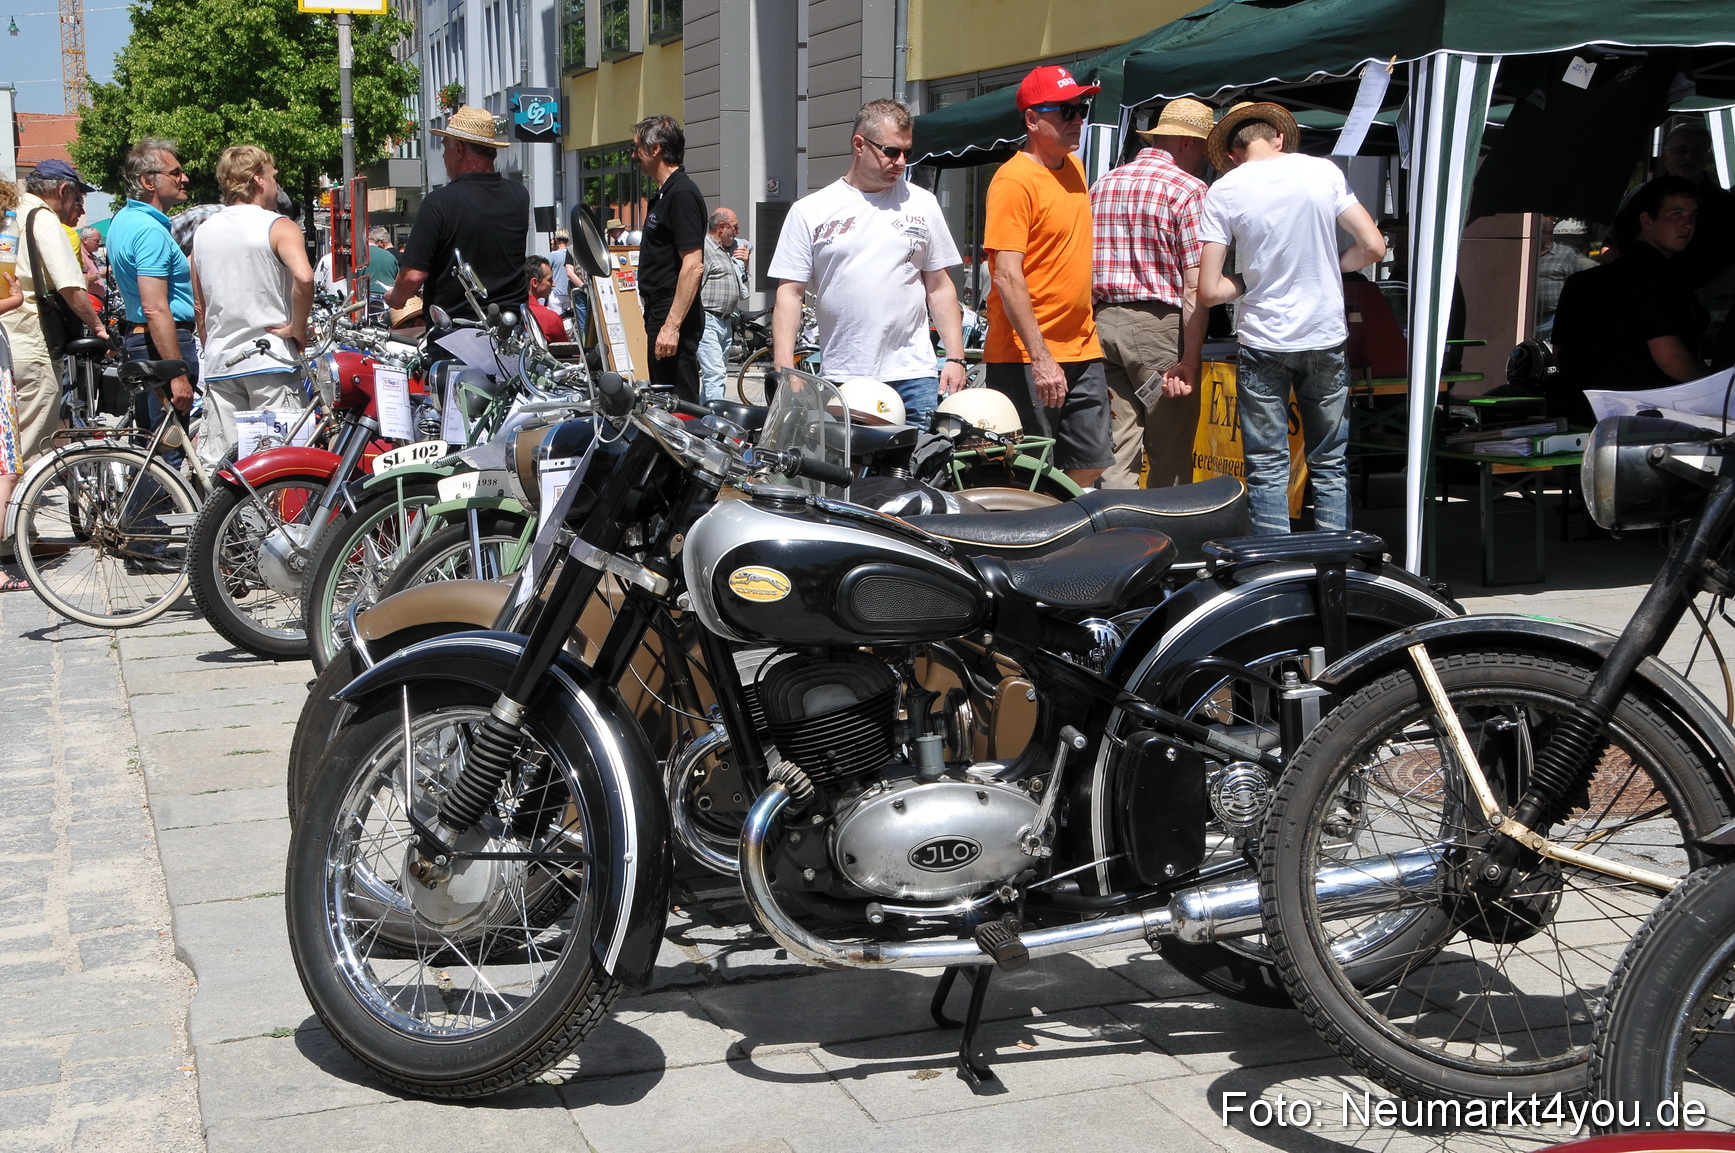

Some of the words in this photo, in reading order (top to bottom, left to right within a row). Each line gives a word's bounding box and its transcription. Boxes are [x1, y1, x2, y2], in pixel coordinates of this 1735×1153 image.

[527, 102, 546, 126] G2
[383, 452, 405, 469] SL
[412, 444, 439, 460] 102
[462, 481, 471, 490] Bj
[478, 479, 498, 487] 1938
[735, 586, 778, 596] EXPRESS
